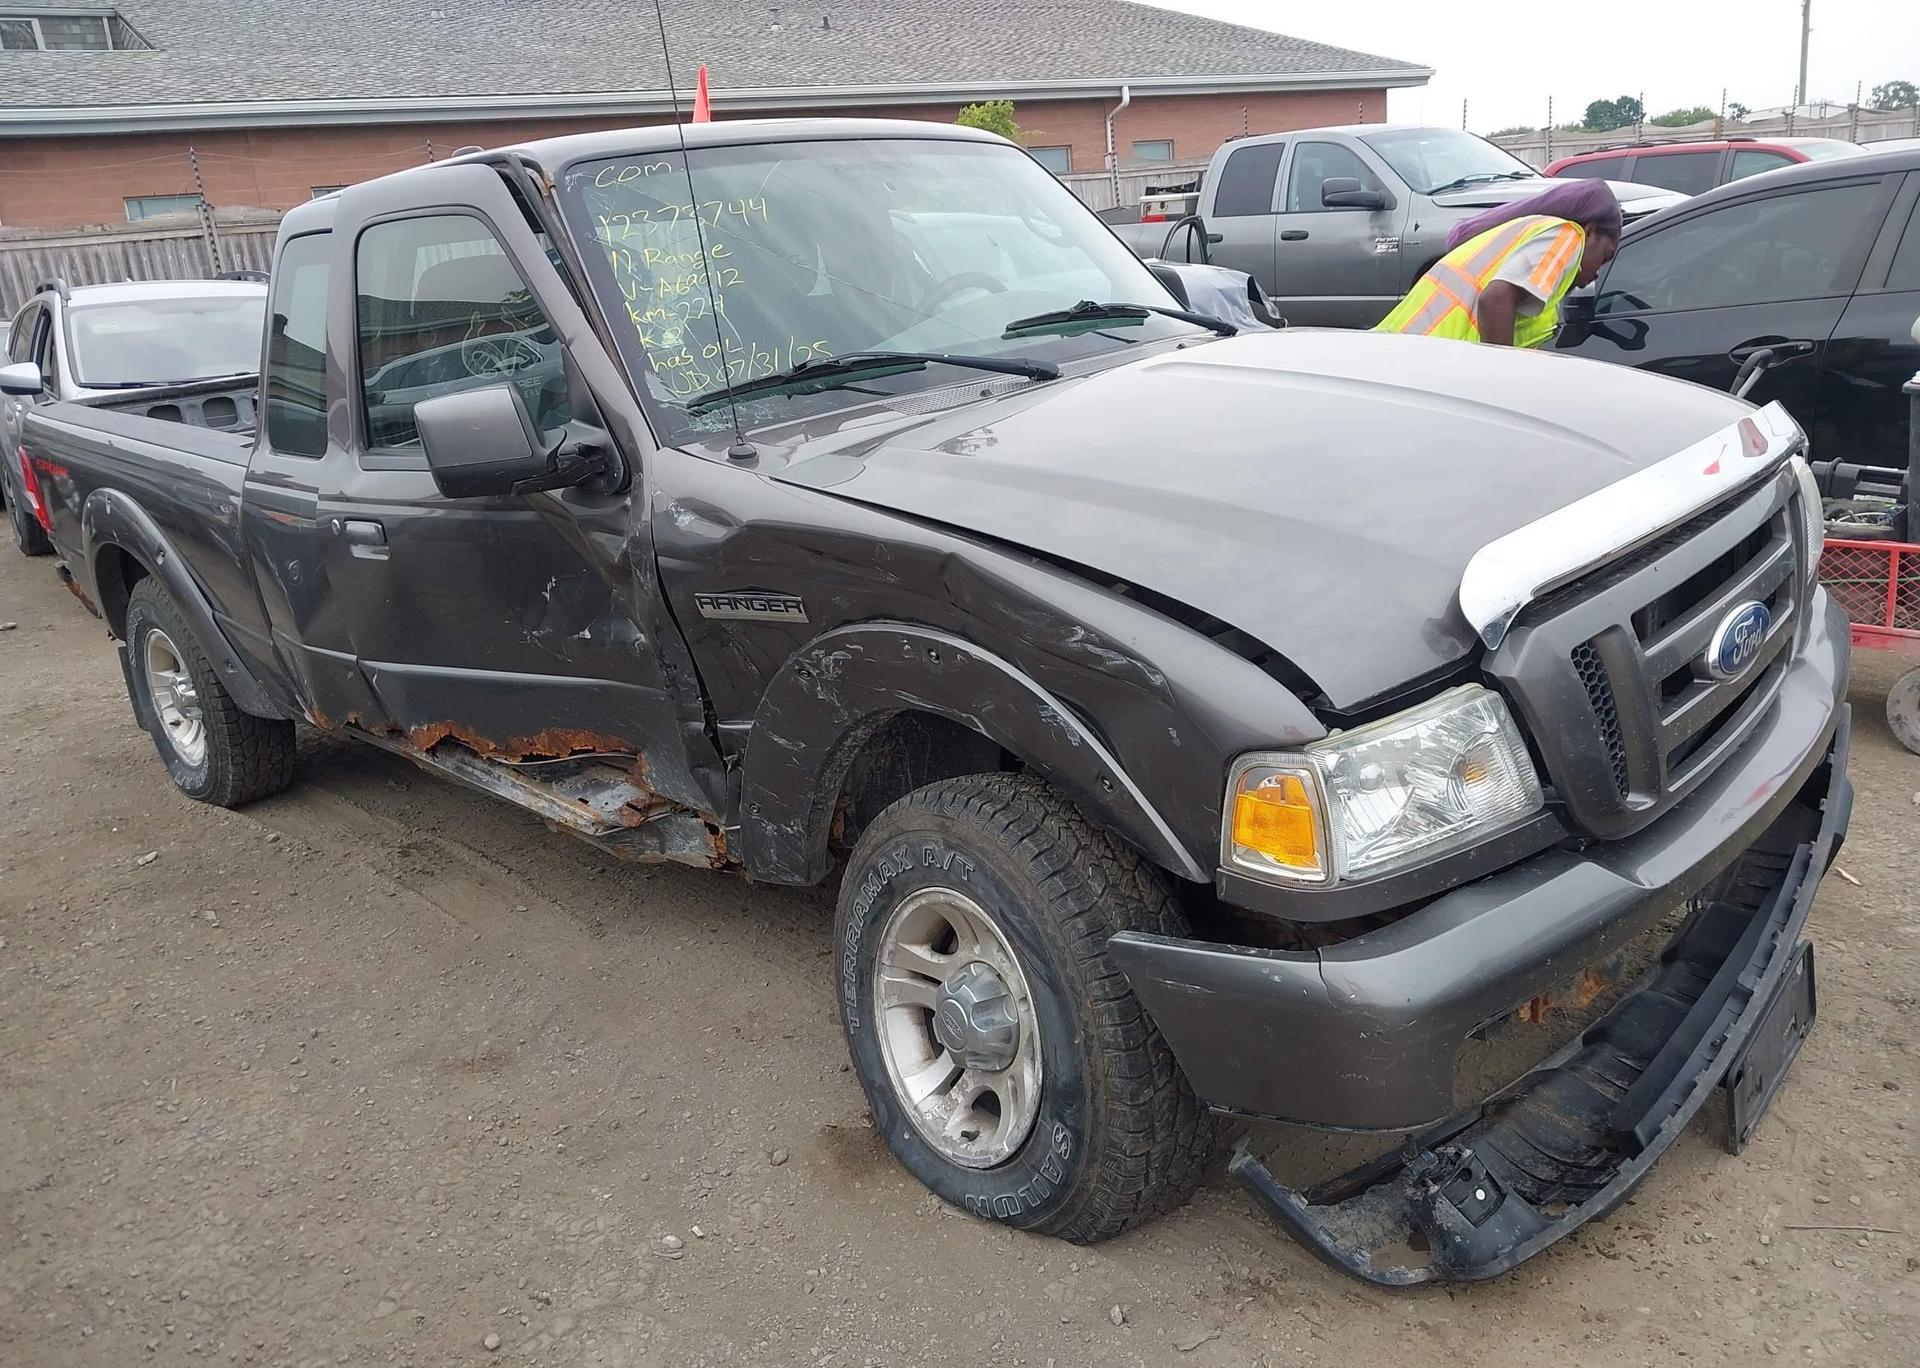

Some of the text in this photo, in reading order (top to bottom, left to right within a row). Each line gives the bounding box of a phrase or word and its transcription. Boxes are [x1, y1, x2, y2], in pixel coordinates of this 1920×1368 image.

[697, 596, 803, 614] RANGER
[1733, 614, 1764, 665] Ford
[840, 844, 976, 1035] TERRAMAX A/T
[965, 1121, 1073, 1220] SAILUN
